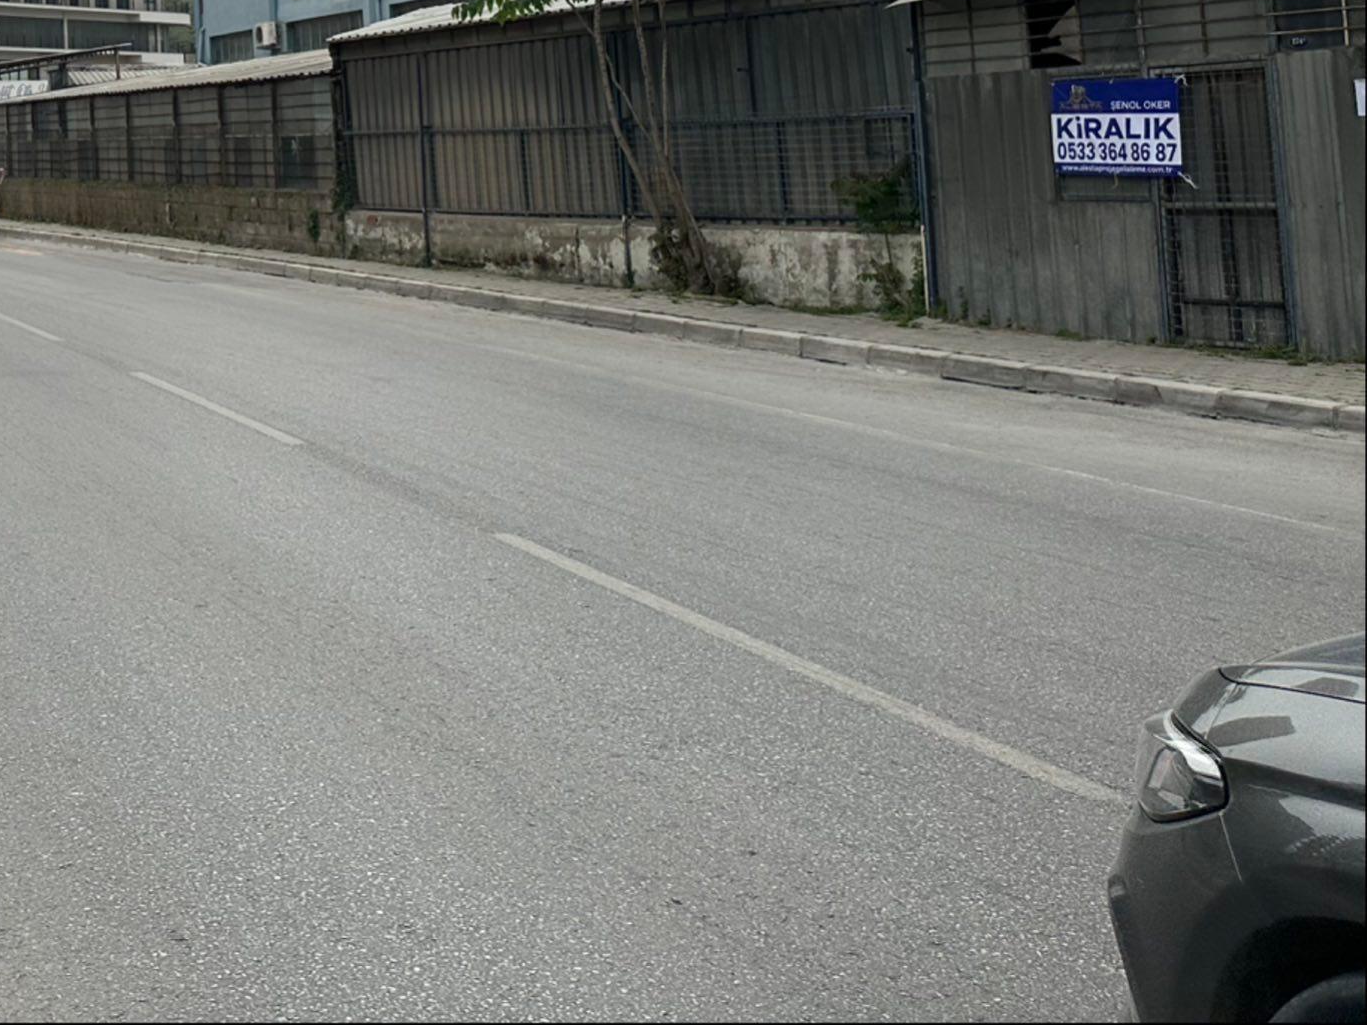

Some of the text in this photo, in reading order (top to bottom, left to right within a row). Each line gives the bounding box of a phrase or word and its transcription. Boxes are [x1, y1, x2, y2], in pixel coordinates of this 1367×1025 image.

[1057, 141, 1177, 162] 0533 364 86 87
